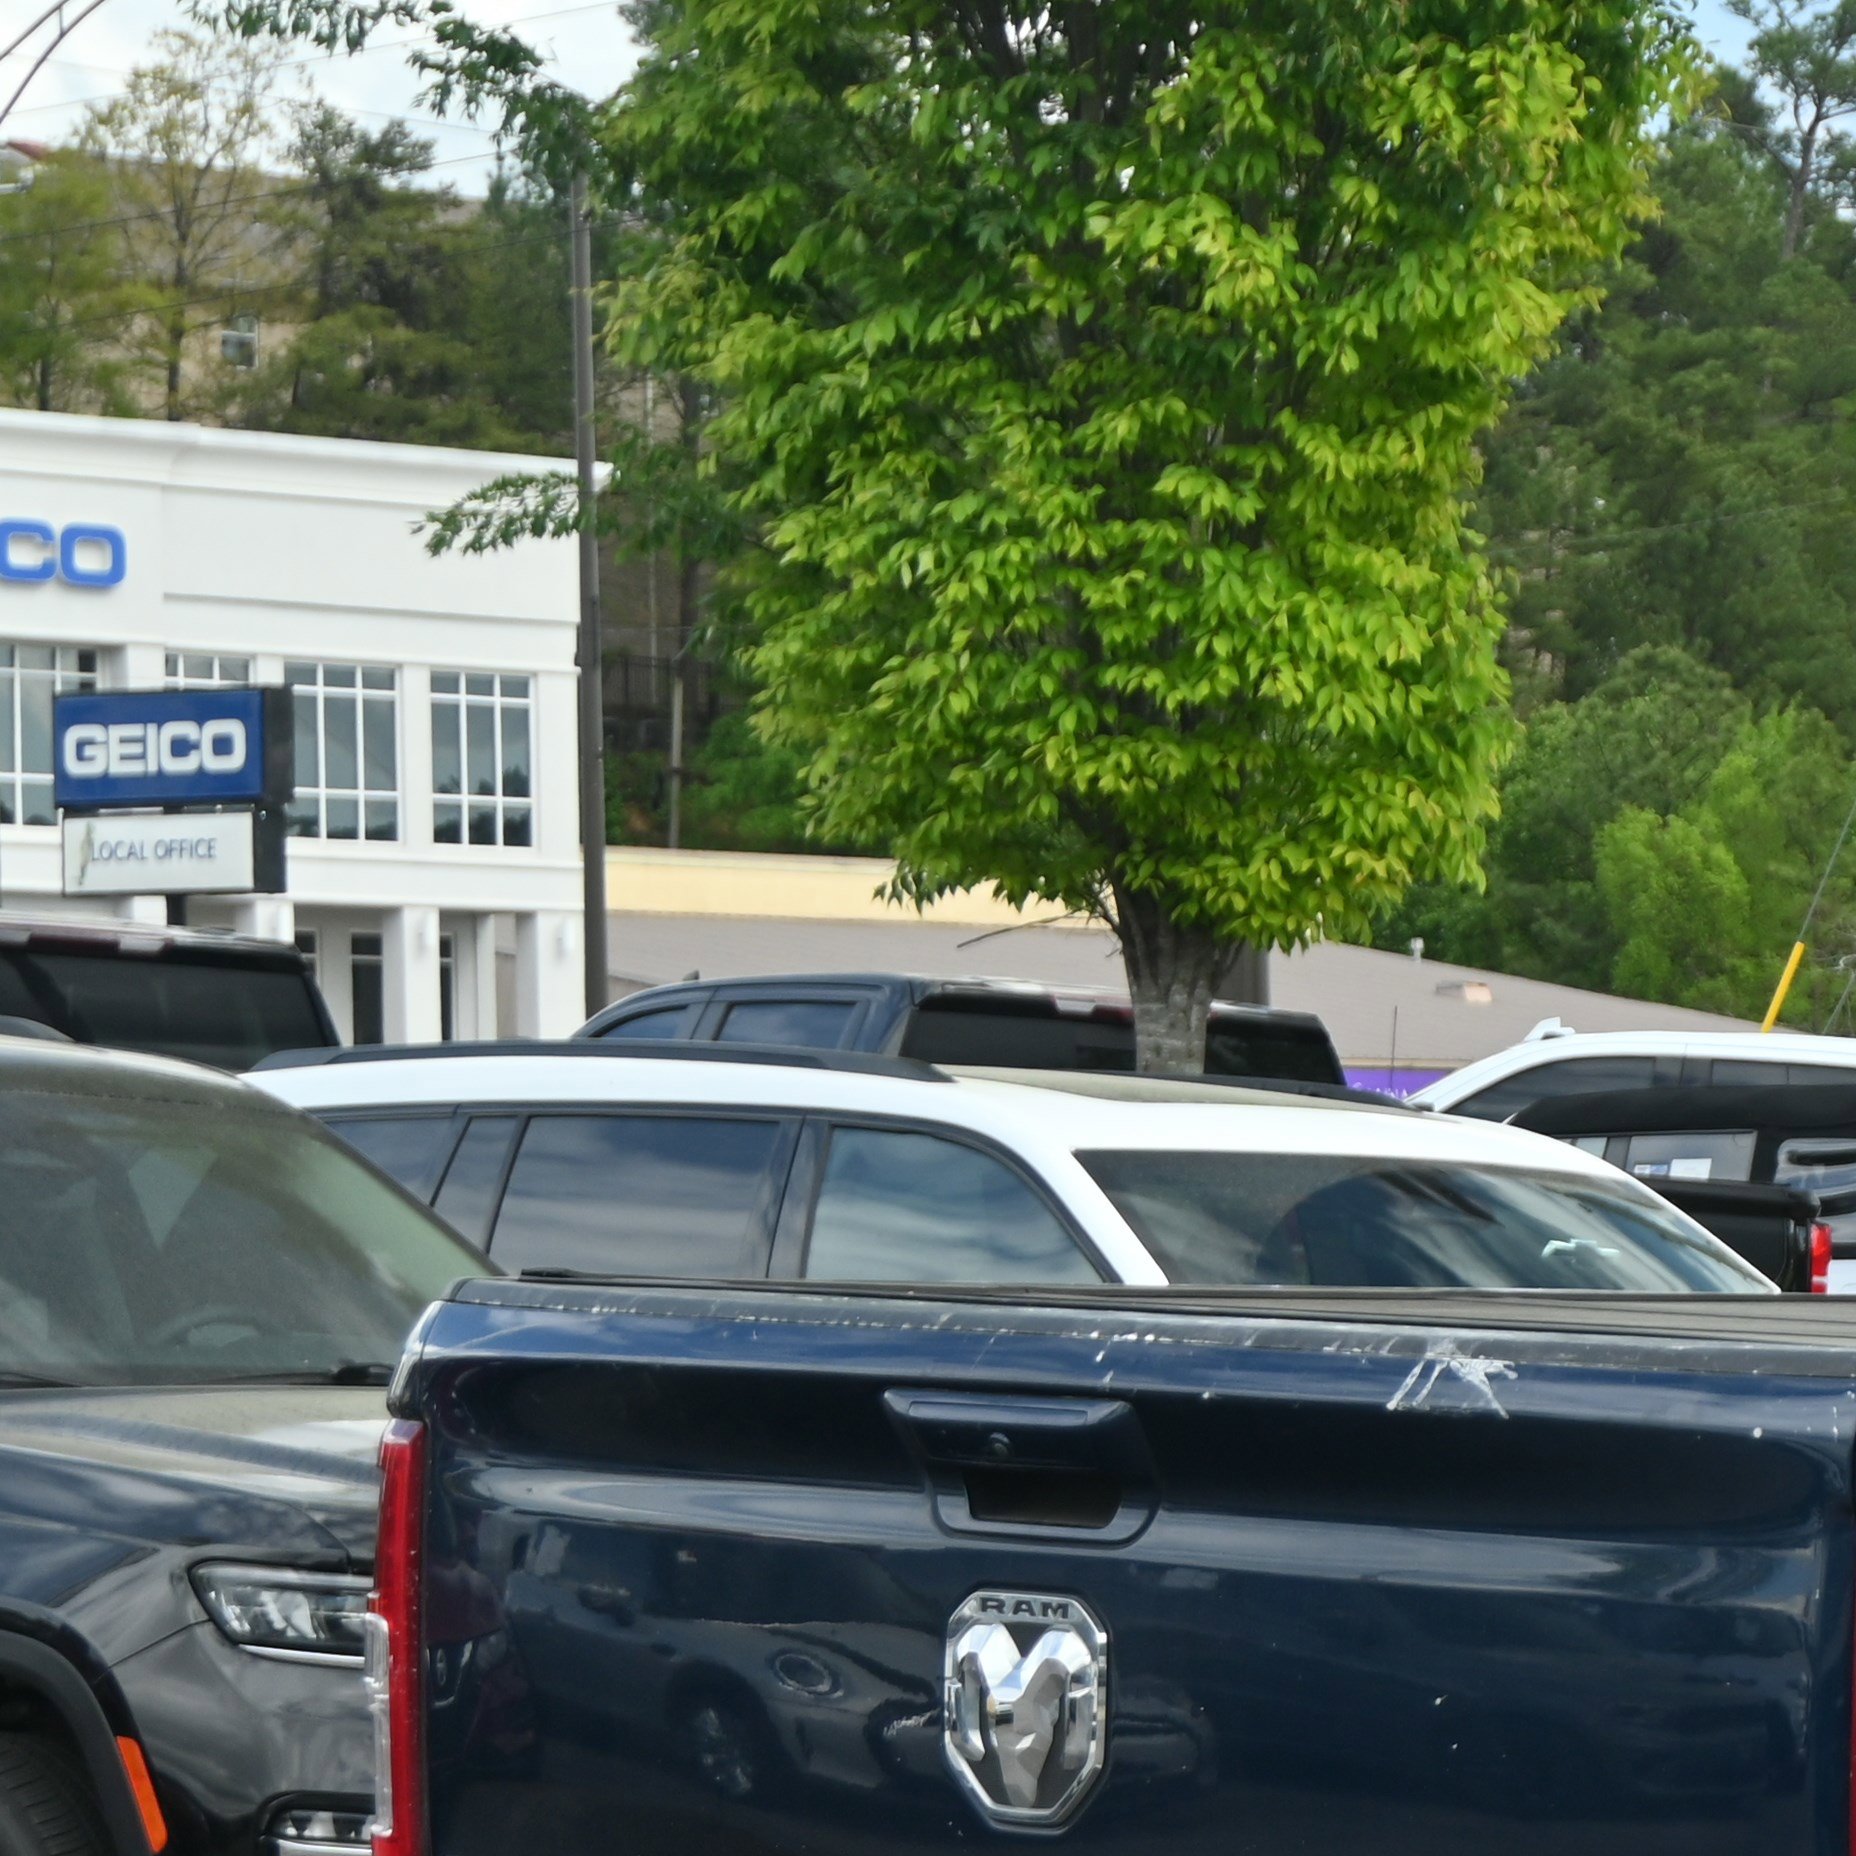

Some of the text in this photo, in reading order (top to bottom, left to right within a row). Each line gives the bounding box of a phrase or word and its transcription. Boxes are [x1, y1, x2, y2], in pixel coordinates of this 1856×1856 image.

[63, 717, 248, 780] GEICO
[92, 837, 218, 862] LOCAL OFFICE
[979, 1597, 1070, 1619] RAM
